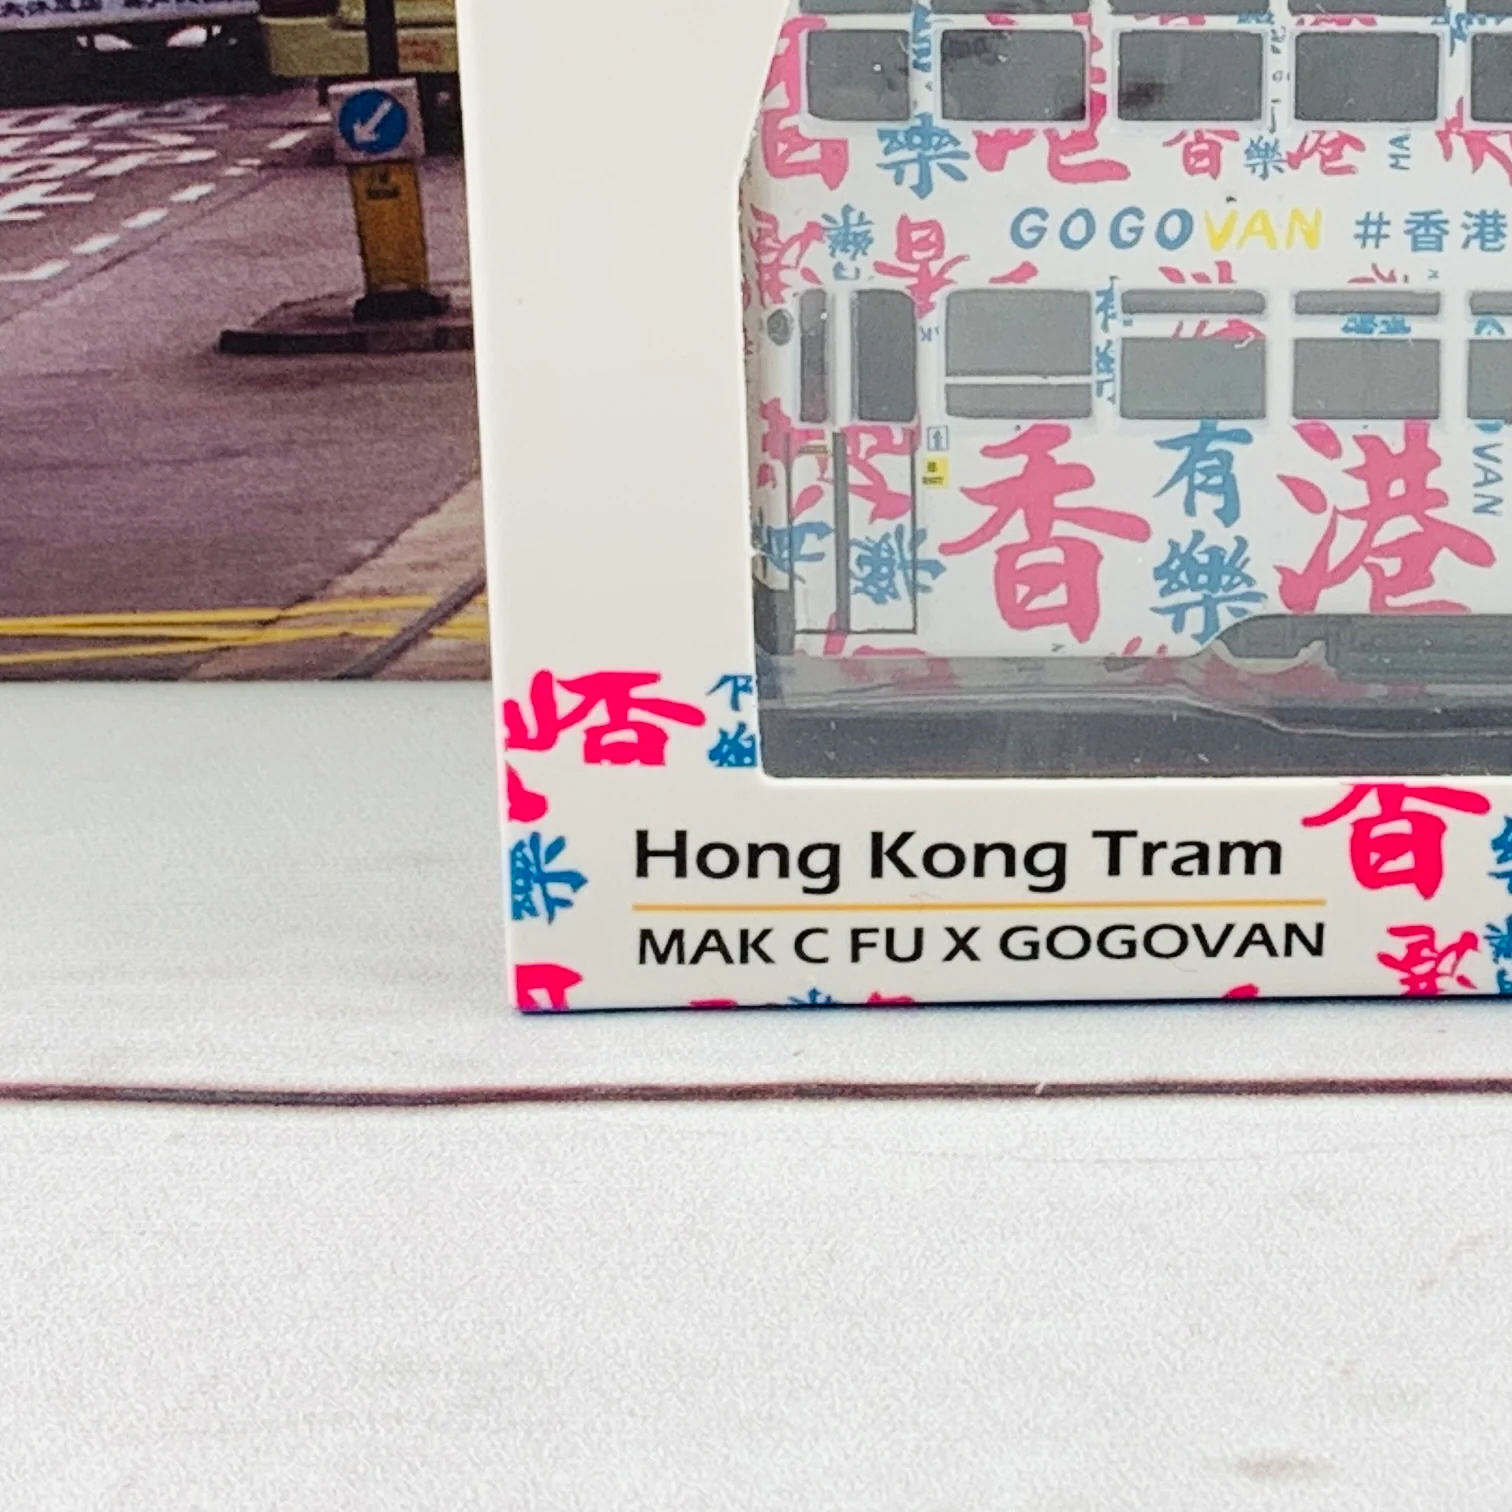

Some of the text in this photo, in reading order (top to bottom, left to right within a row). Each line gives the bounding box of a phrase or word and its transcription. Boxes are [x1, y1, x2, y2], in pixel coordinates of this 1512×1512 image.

[1009, 205, 1324, 252] GOGOVAN
[938, 418, 1497, 649] 香 有樂 港
[635, 829, 1282, 895] Hong Kong Tram
[638, 921, 1327, 965] MAK C FU X GOGOVAN
